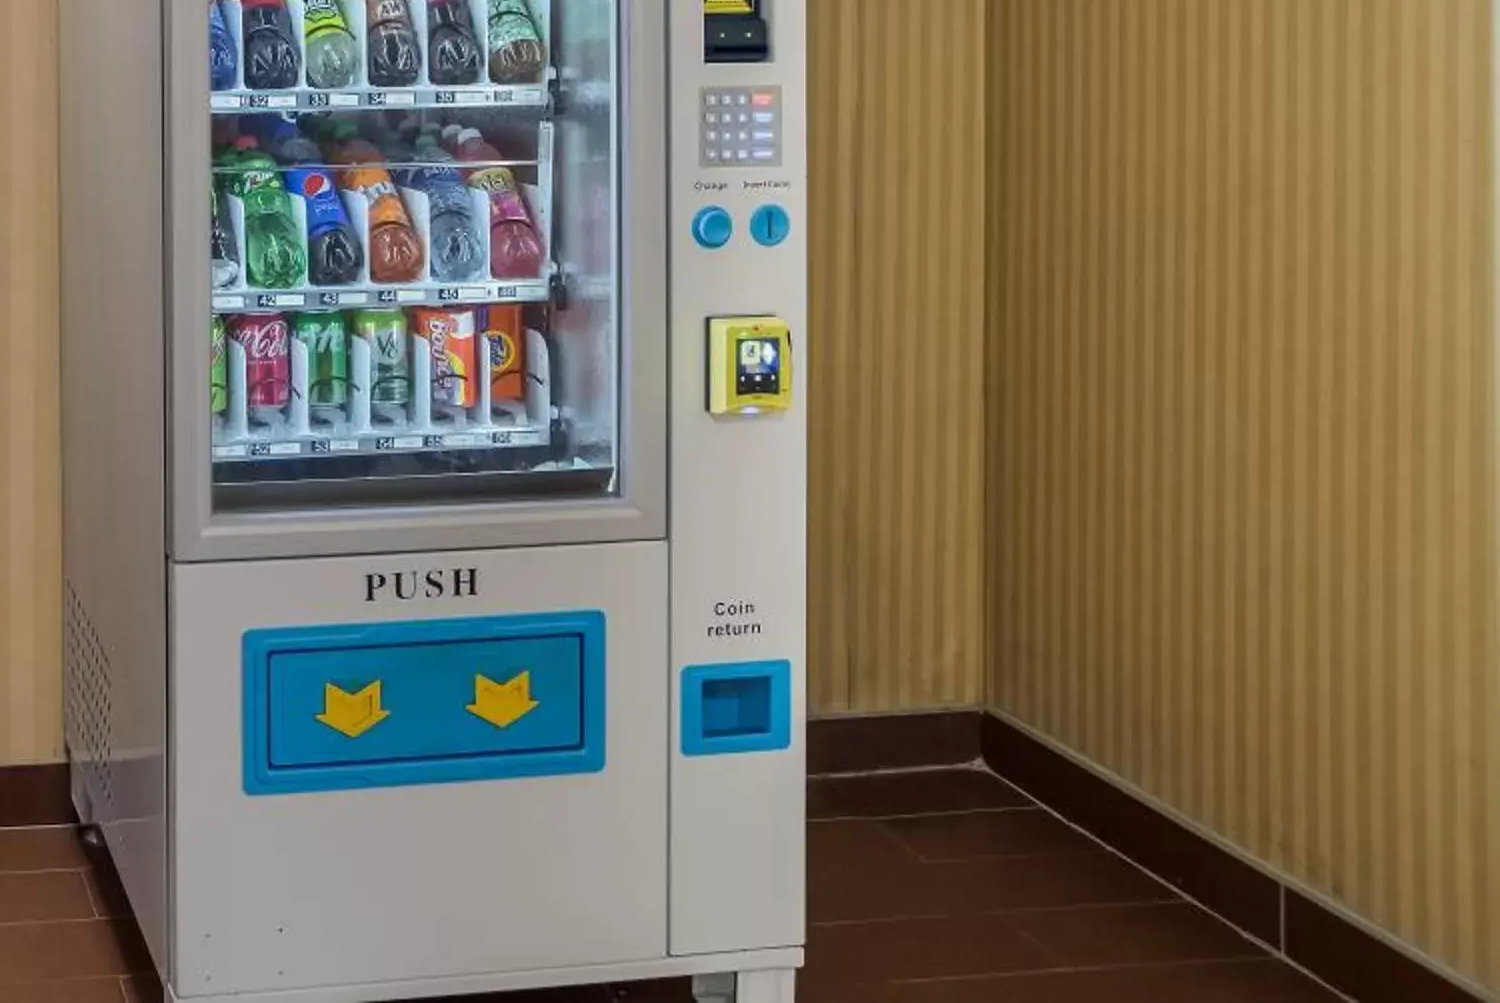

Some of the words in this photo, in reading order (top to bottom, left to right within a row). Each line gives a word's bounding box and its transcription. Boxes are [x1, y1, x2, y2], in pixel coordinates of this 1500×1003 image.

[364, 568, 479, 602] PUSH
[713, 601, 755, 617] Coin
[707, 622, 762, 638] return
